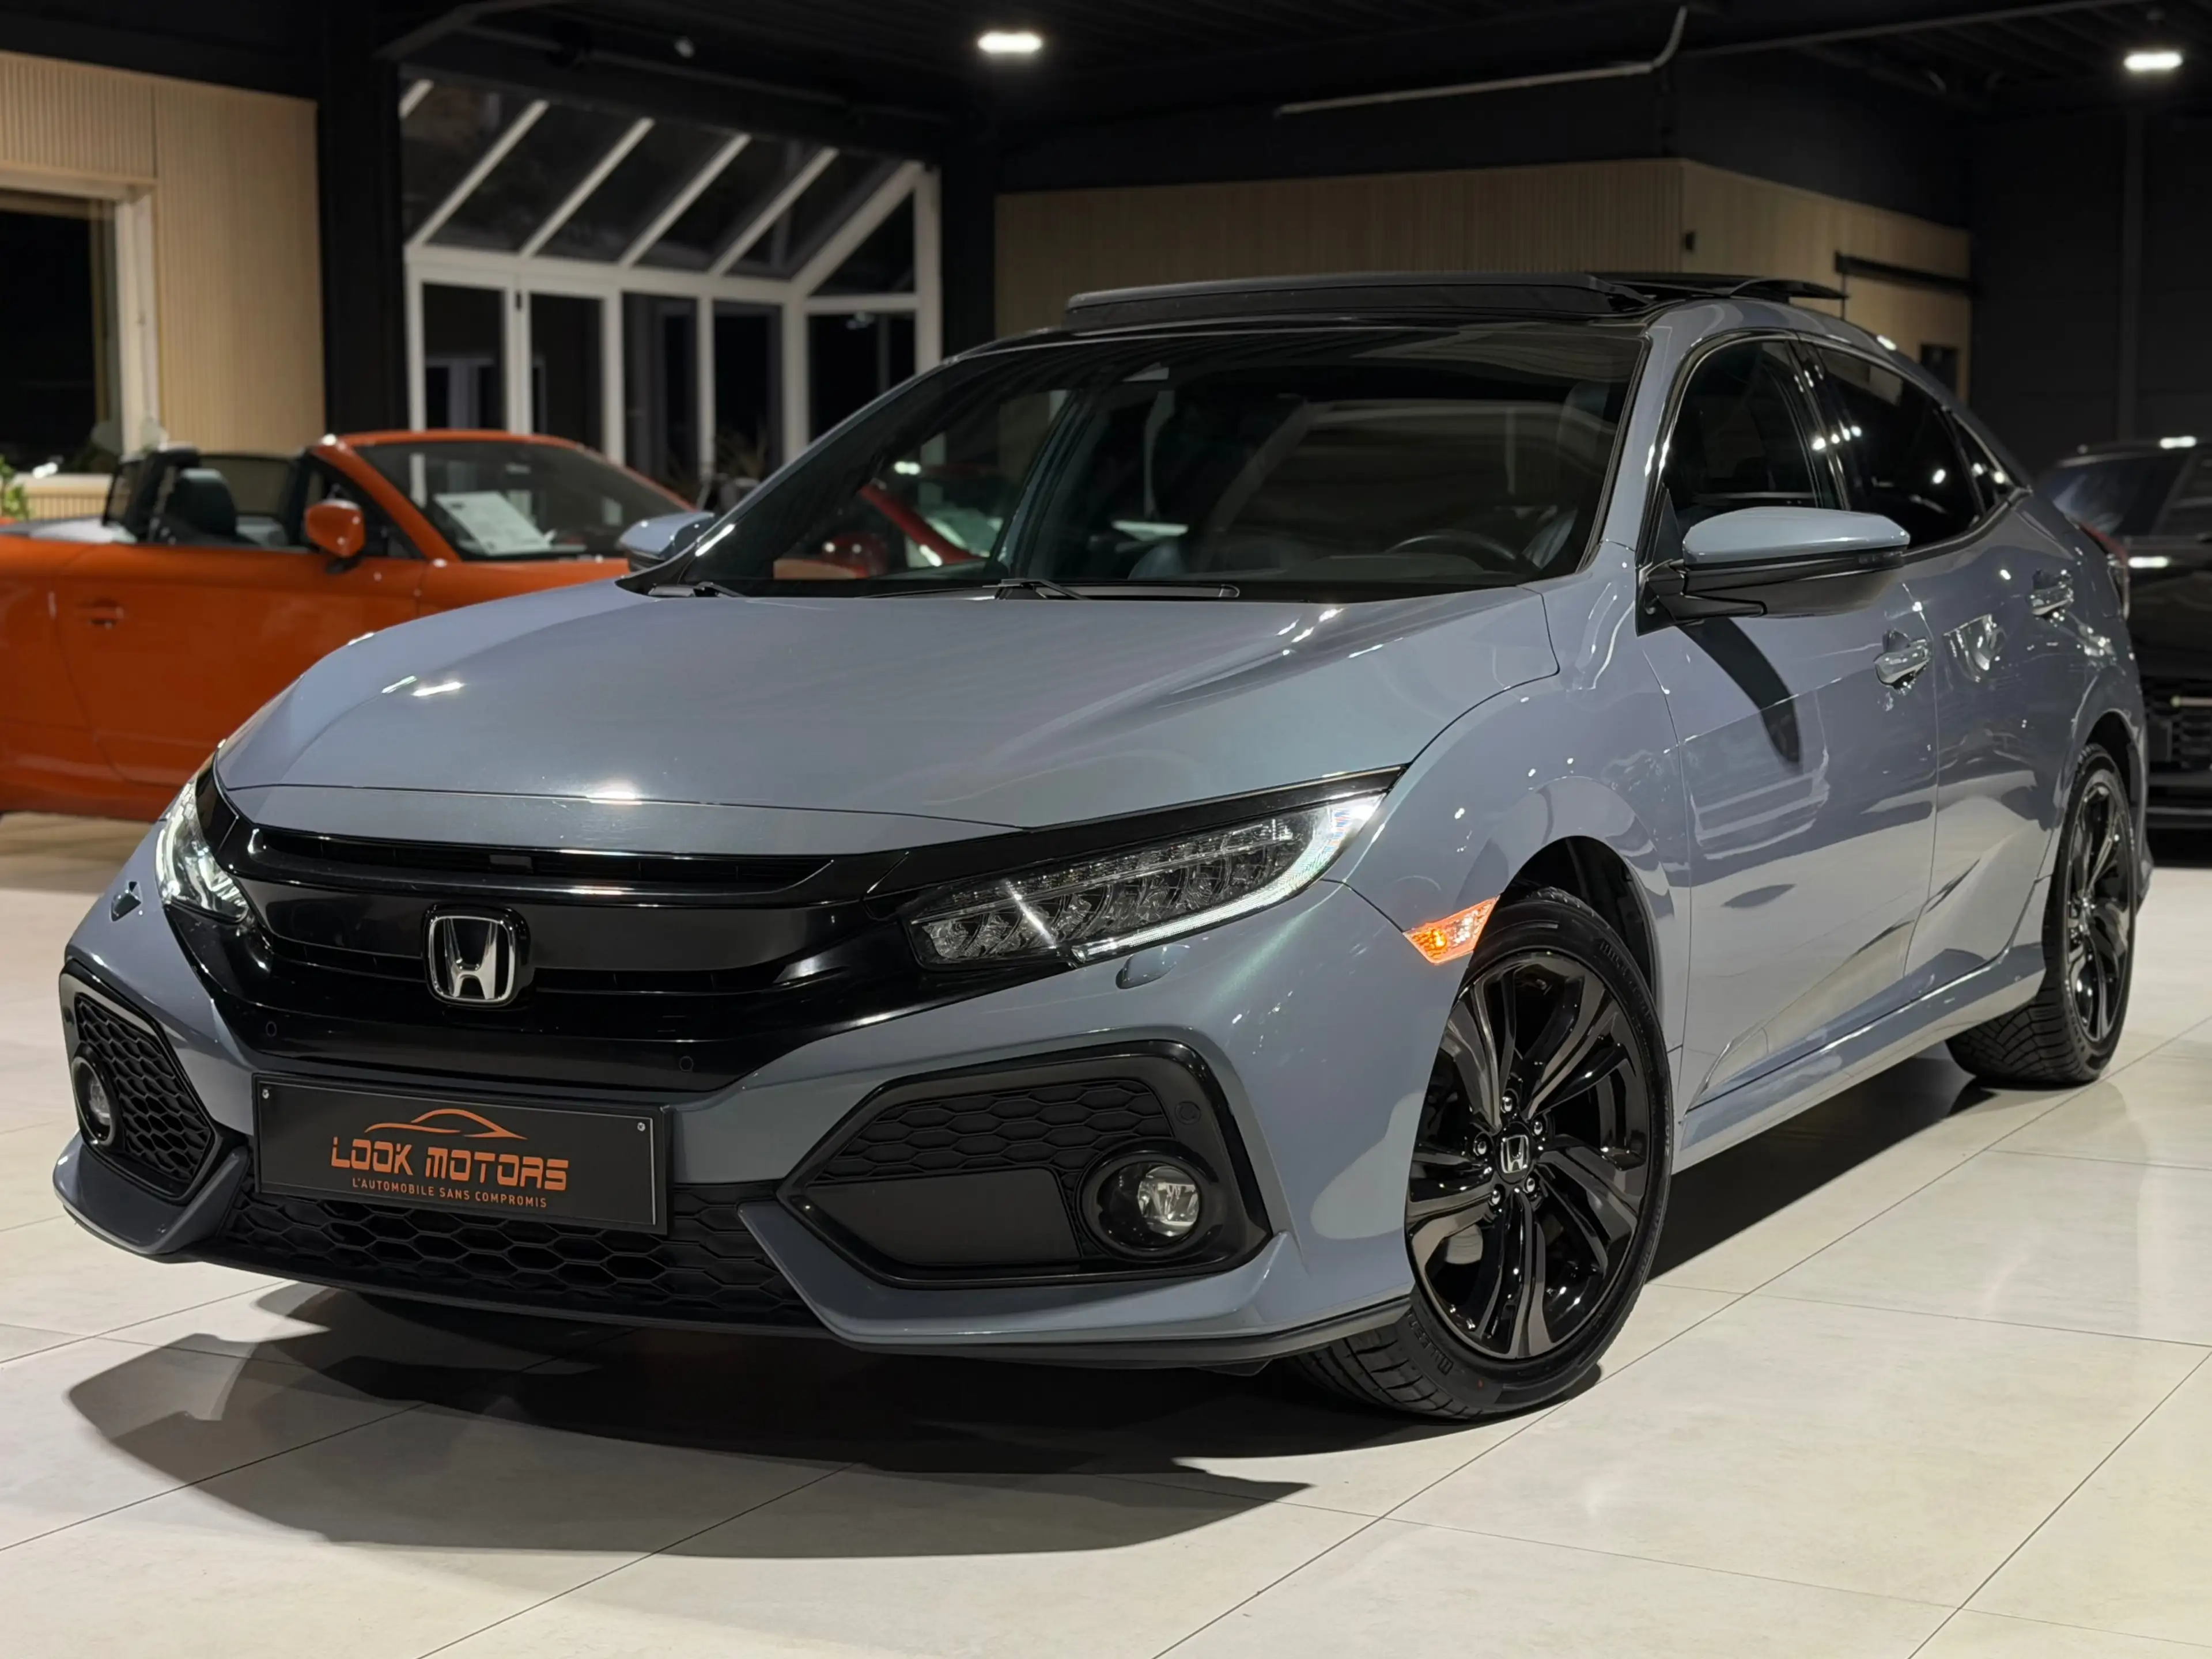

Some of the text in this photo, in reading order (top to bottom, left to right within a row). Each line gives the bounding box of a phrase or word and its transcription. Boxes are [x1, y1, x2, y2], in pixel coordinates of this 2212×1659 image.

[331, 1137, 569, 1191] LOOK MOTORS
[352, 1177, 547, 1208] L'AUTOMOBILE SANS COMPROMIS
